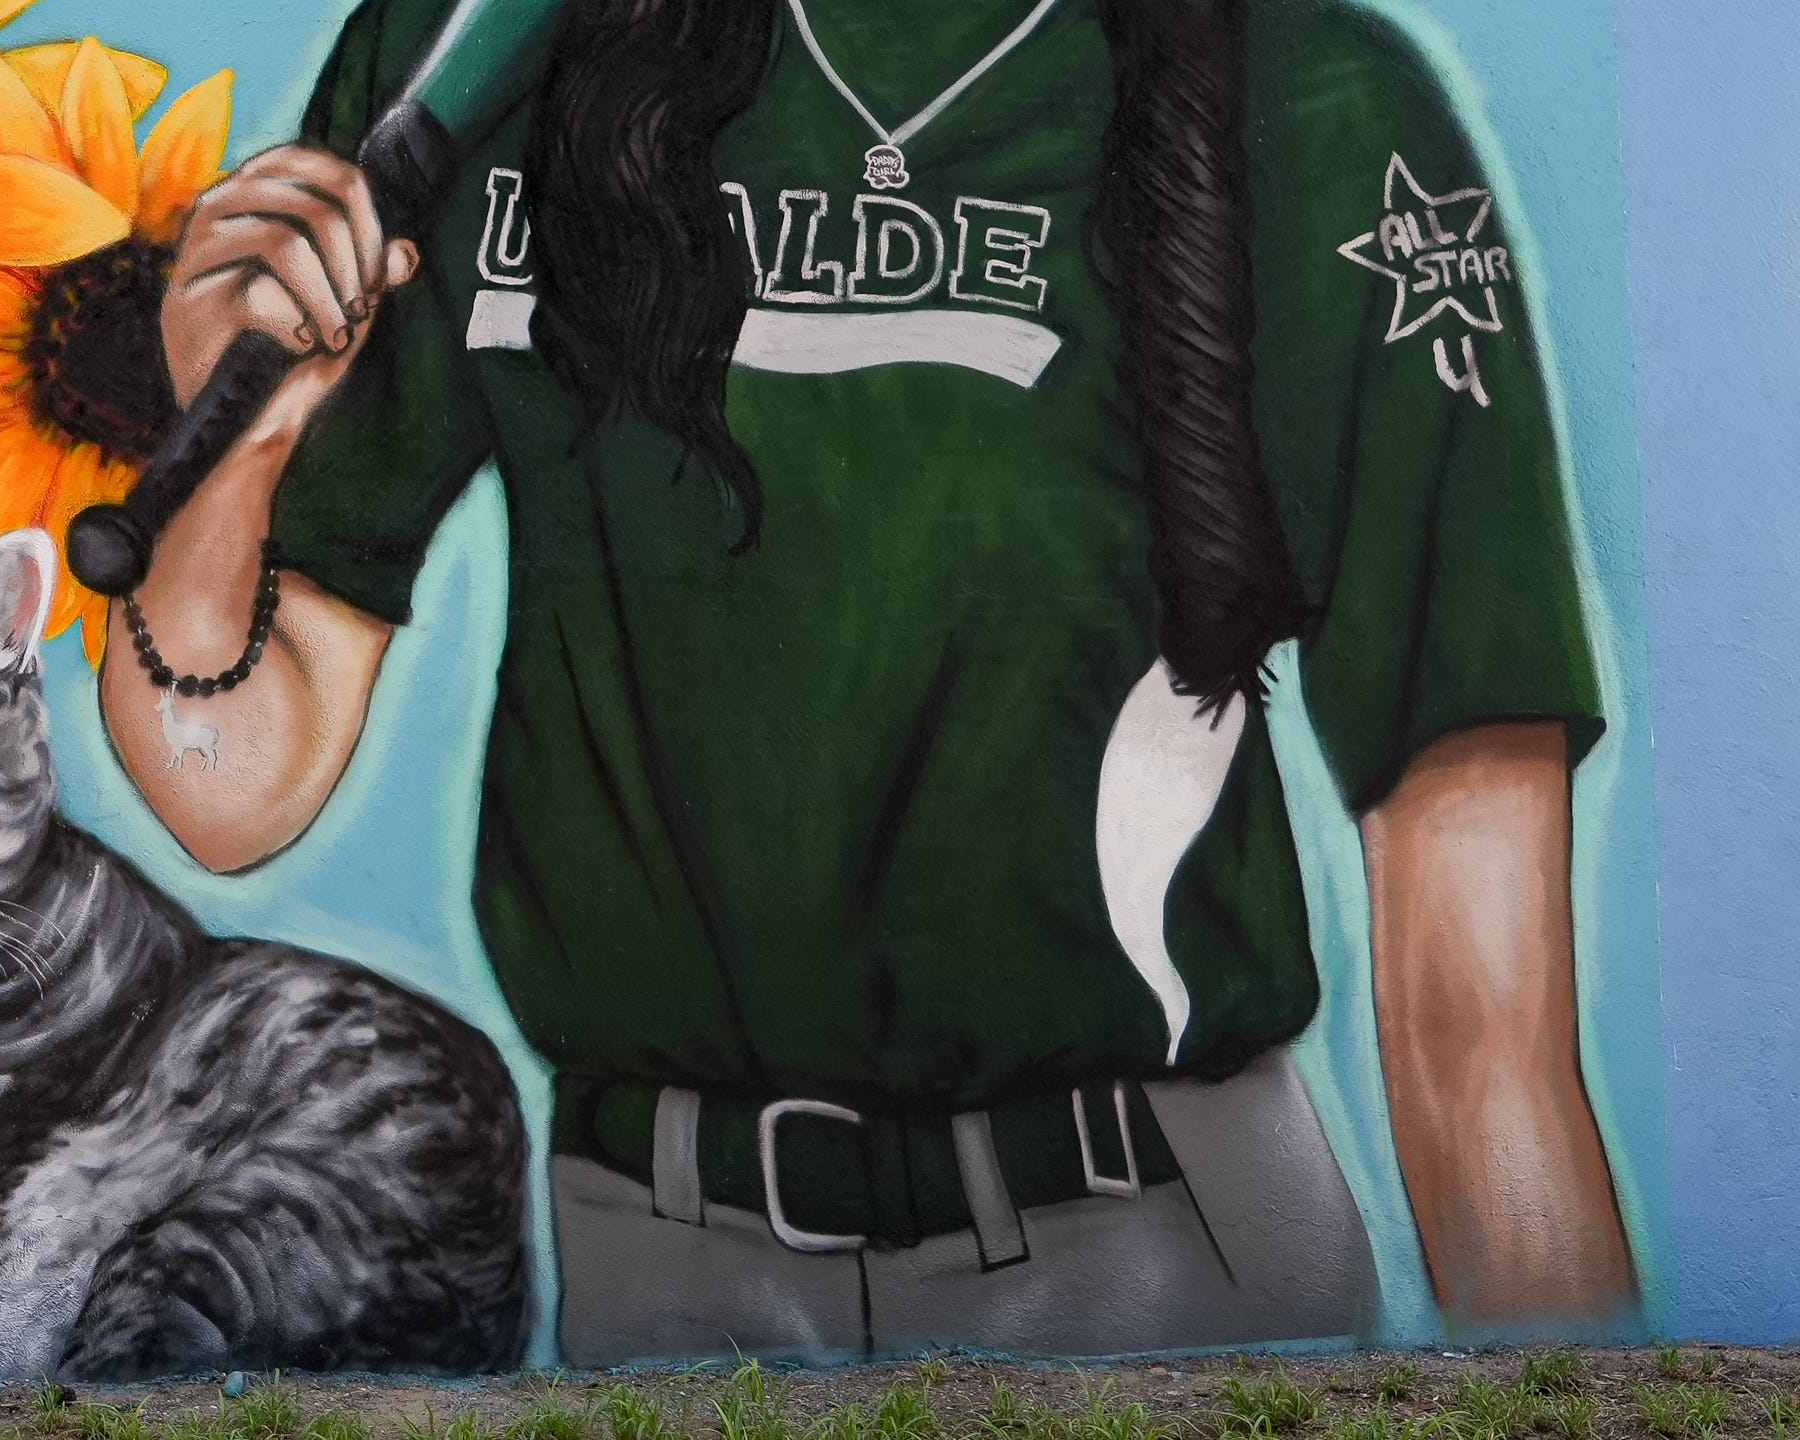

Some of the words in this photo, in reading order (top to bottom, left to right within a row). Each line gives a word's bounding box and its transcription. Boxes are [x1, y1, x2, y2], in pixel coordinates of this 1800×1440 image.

[871, 166, 896, 176] GIRL
[1379, 206, 1458, 260] ALL
[1412, 246, 1511, 293] STAR
[1432, 334, 1491, 407] 4
